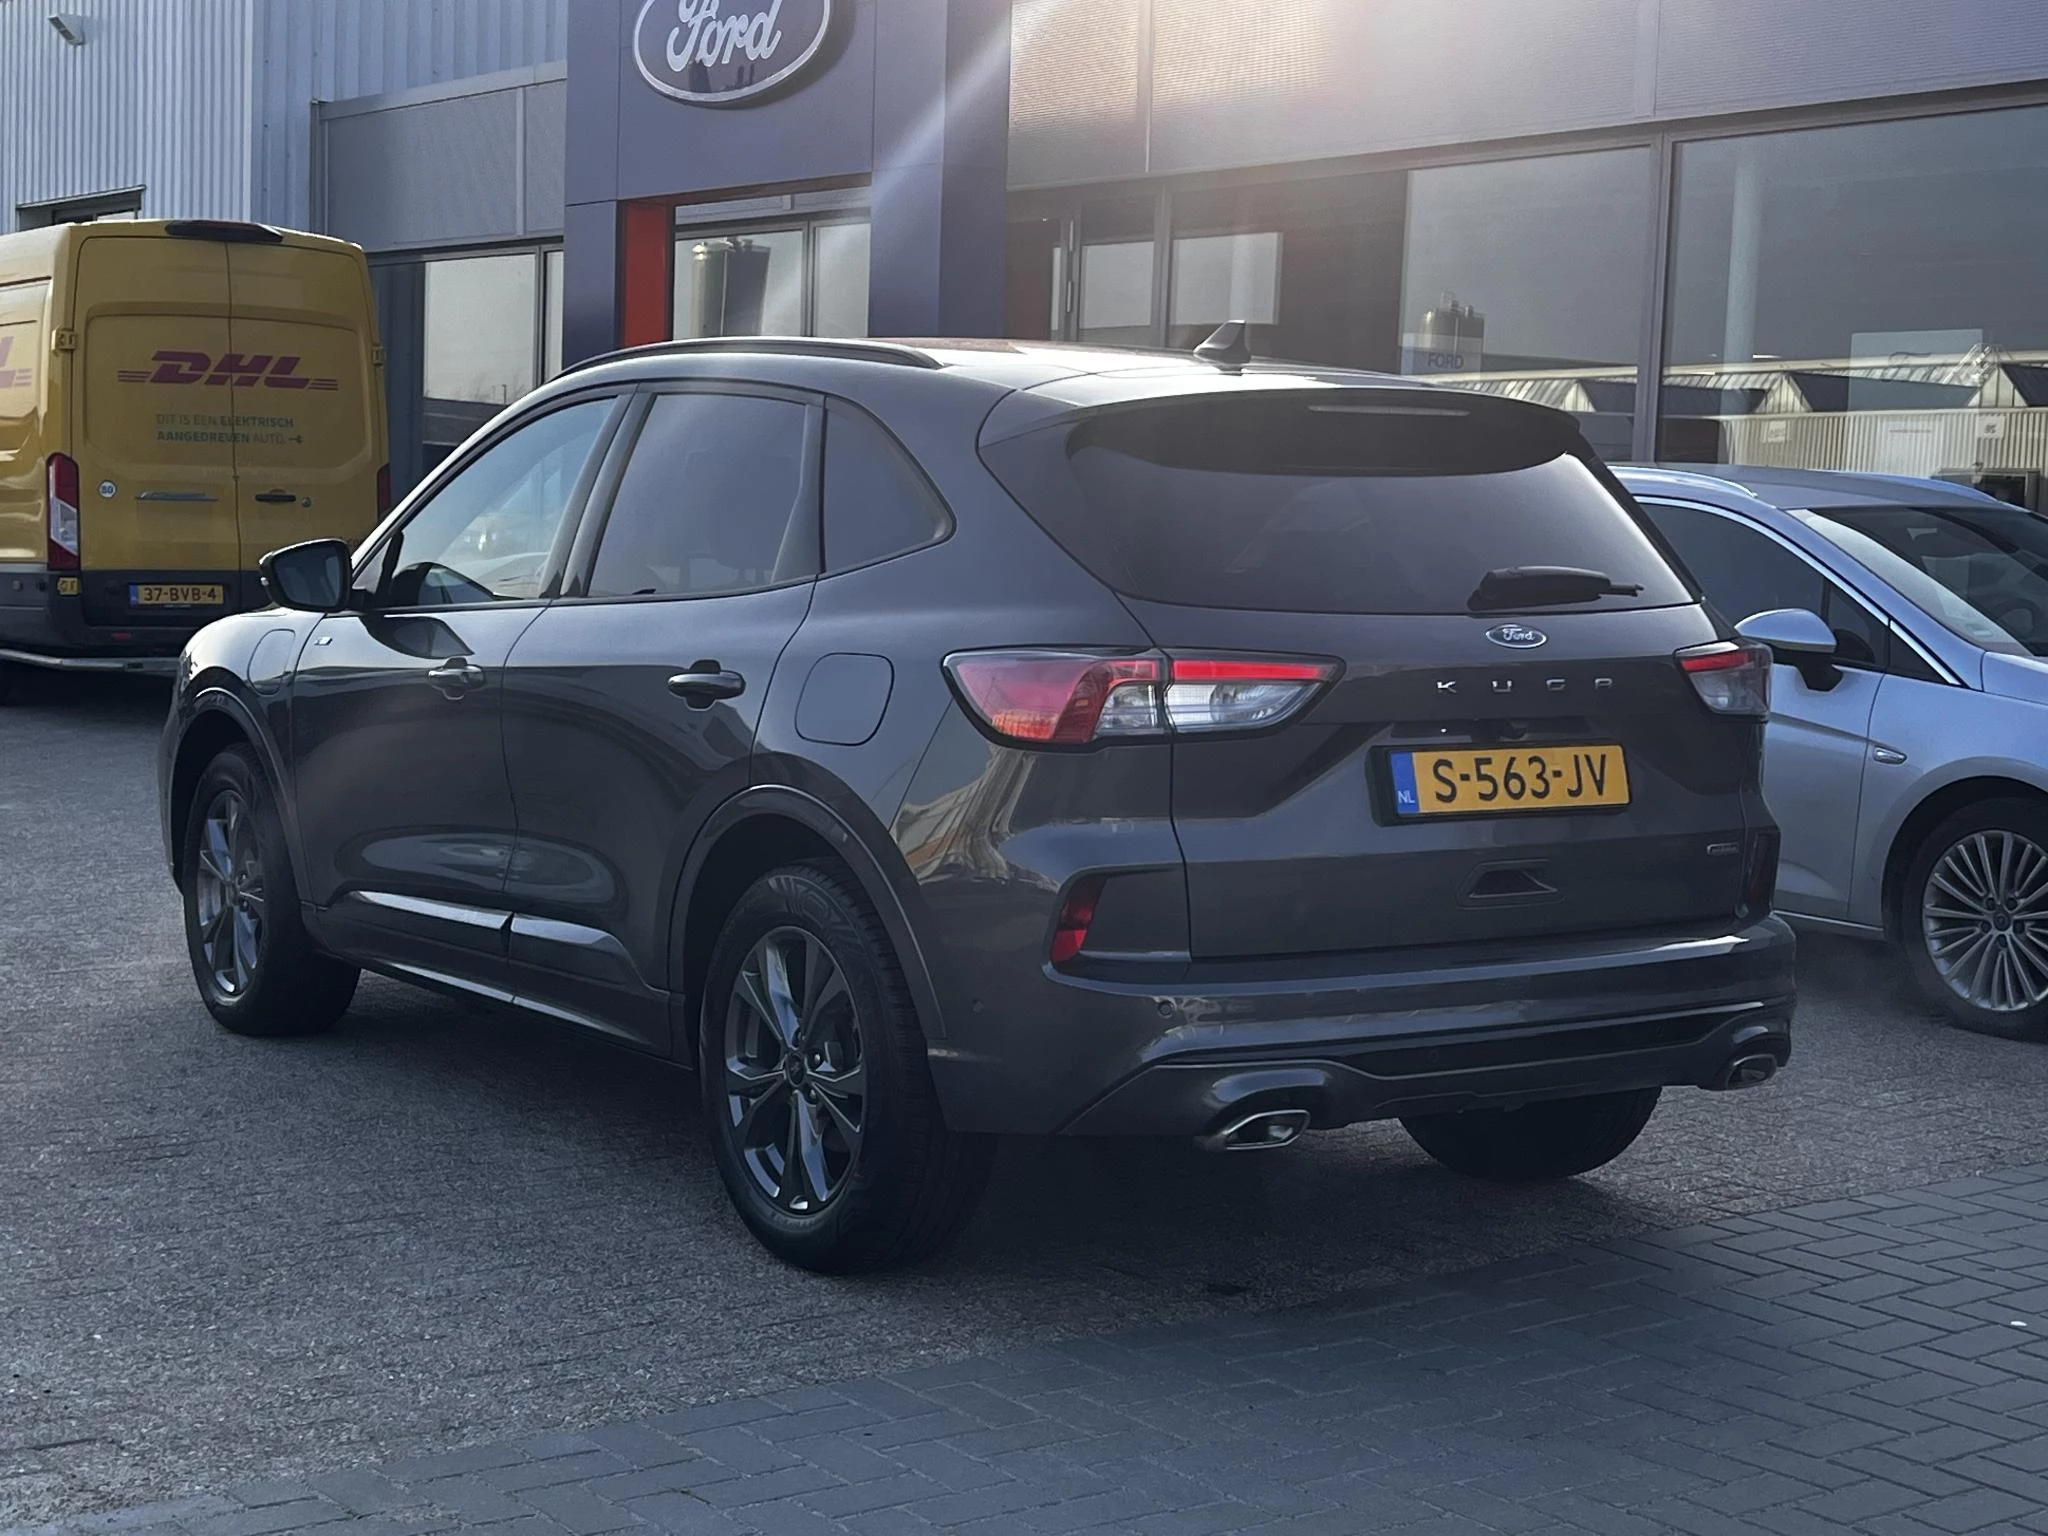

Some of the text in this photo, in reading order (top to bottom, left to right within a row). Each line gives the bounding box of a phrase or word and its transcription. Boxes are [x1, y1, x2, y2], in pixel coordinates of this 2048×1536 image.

[667, 0, 782, 72] Ford
[149, 350, 310, 390] DHL
[219, 415, 294, 428] ELEKTRISCH
[156, 431, 249, 443] AANGEDREVEN
[143, 587, 217, 602] 37-BVB-4
[1502, 628, 1536, 641] Ford
[1432, 754, 1606, 804] S-563-JV
[1397, 790, 1416, 804] NL
